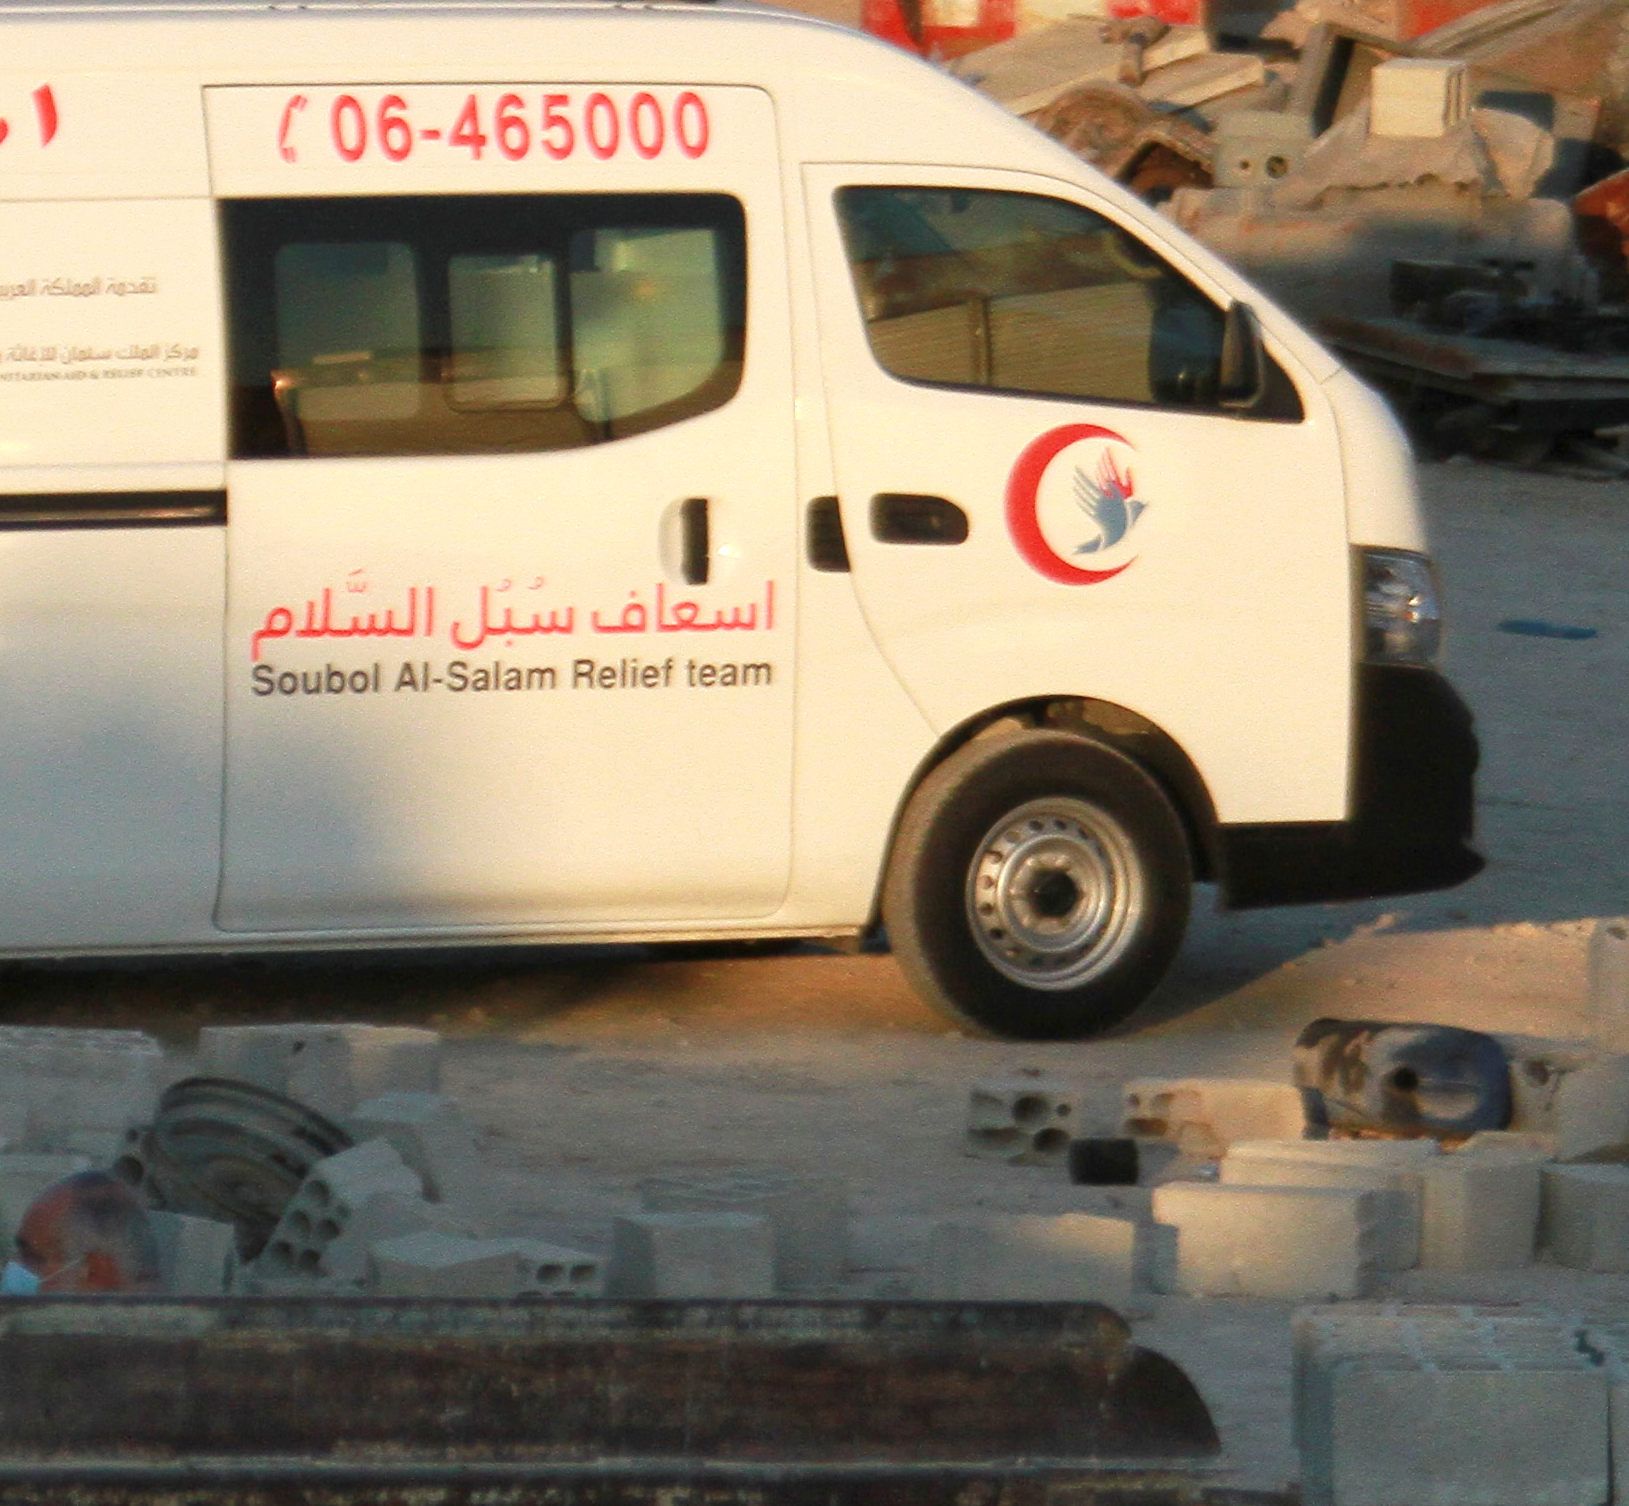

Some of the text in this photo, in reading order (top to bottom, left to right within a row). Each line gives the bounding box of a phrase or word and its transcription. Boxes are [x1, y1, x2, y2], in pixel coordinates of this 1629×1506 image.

[328, 90, 710, 163] 06-465000
[590, 579, 775, 634] اسعاف
[251, 655, 774, 696] Soubol Al-Salam Relief team
